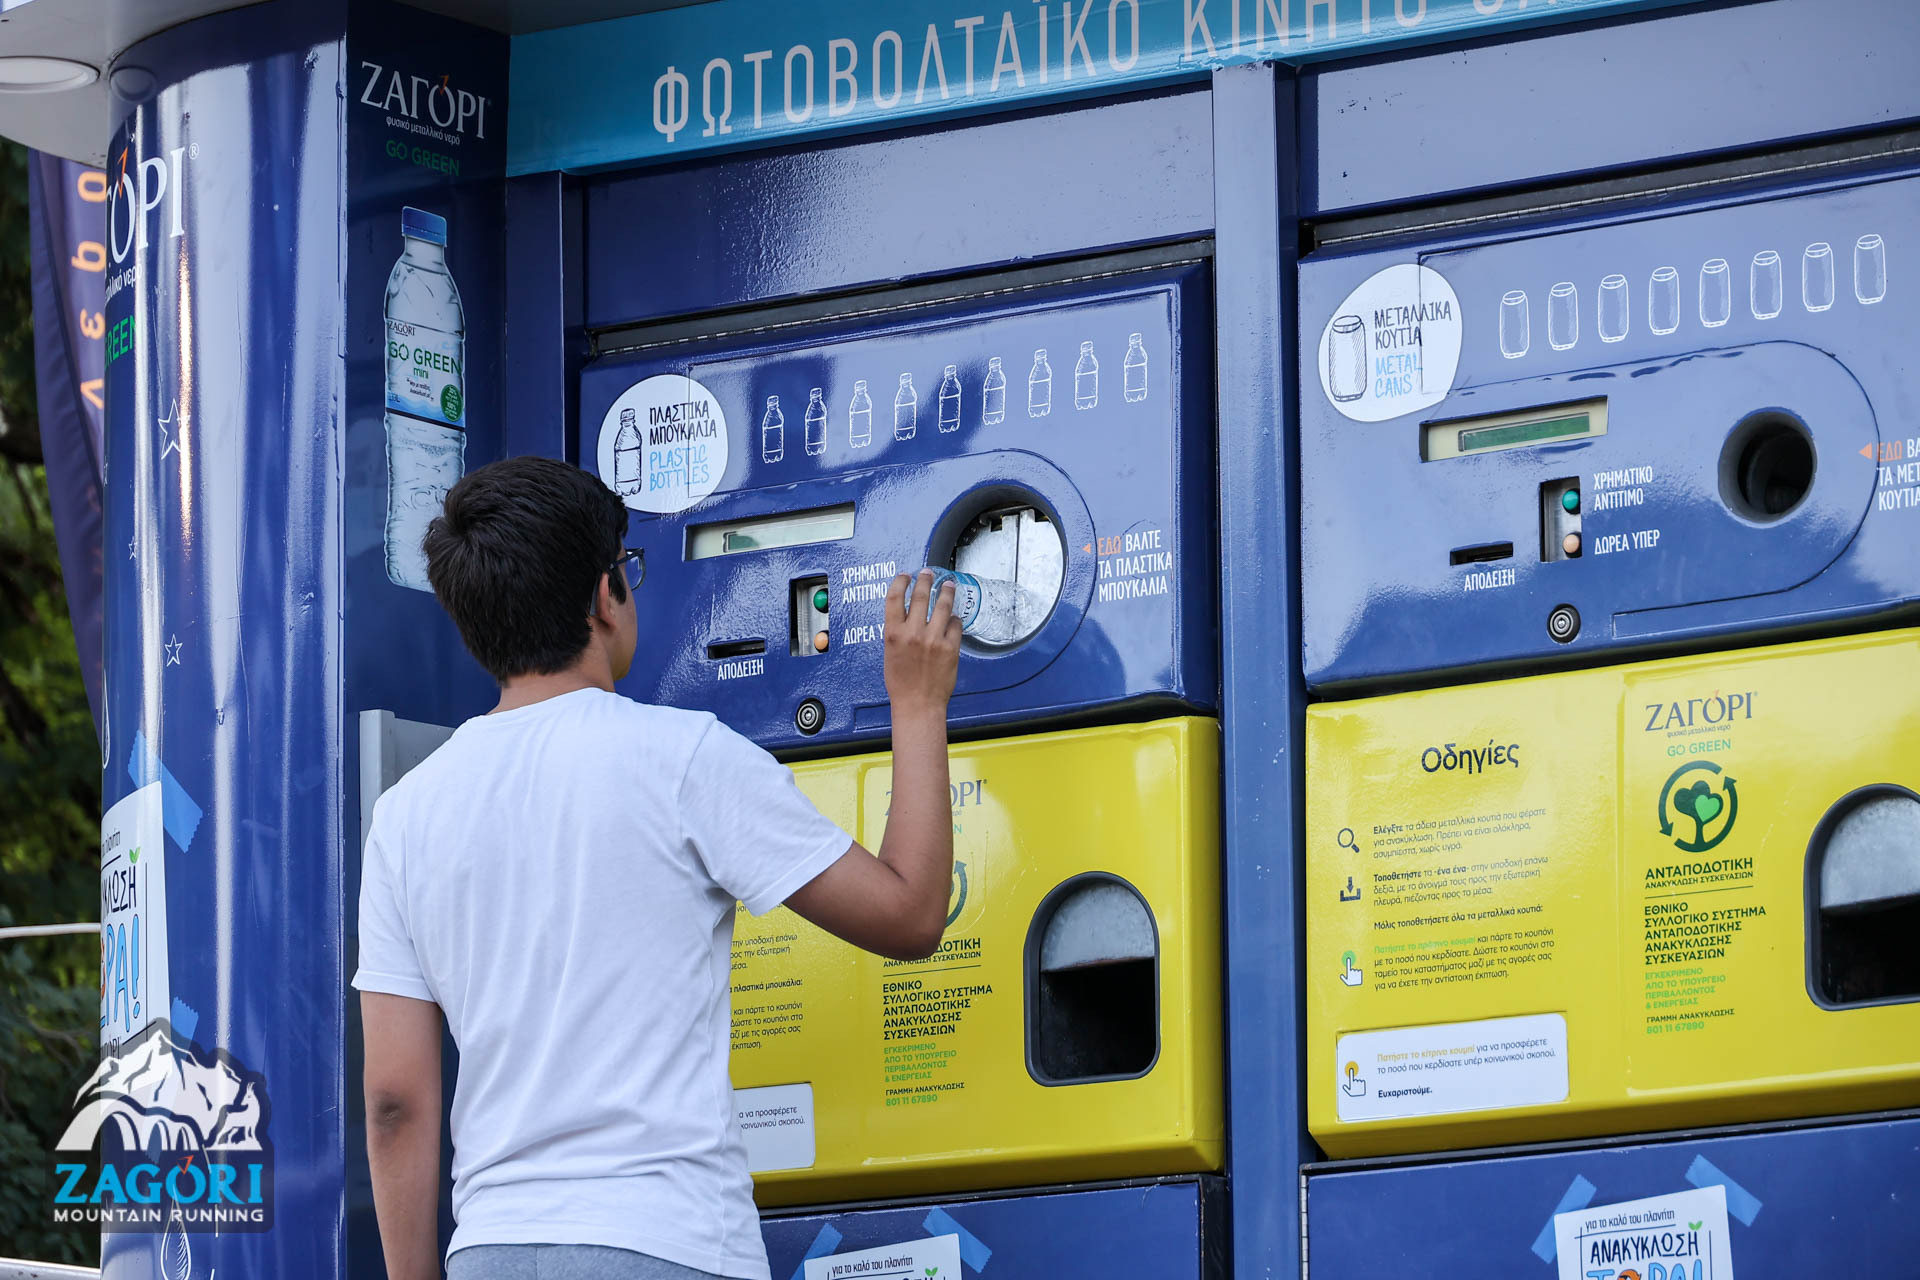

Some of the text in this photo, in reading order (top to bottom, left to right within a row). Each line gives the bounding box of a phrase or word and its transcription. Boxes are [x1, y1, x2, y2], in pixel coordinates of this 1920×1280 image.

[386, 140, 460, 176] GO GREEN
[1375, 301, 1452, 329] ΜΕΤΑΛΛΙΚΑ
[1375, 326, 1422, 350] ΚΟΥΤΙΑ
[389, 341, 463, 376] GO GREEN
[1375, 353, 1423, 377] METAL
[413, 367, 429, 379] mini
[1375, 374, 1413, 398] CANS
[650, 400, 710, 425] ΠΛΑΣΤΙΚΑ
[650, 419, 717, 446] ΜΠΟΥΚΑΛΙΑ
[650, 444, 708, 470] PLASTIC
[650, 464, 710, 491] BOTTLES
[1593, 466, 1653, 490] ΧΡΗΜΑΤΙΚΟ
[1877, 466, 1893, 486] ΤΑ
[1594, 488, 1644, 511] ΑΝΤΙΤΙΜΟ
[1097, 530, 1161, 556] ΕΔΩ ΒΑΛΤΕ
[1594, 529, 1660, 555] ΔΩΡΕΑ ΥΠΕΡ
[841, 561, 896, 584] ΧΡΗΜΑΤΙΚΟ
[1098, 551, 1172, 579] ΤΑ ΠΛΑΣΤΙΚΑ
[1099, 576, 1168, 602] ΜΠΟΥΚΑΛΙΑ
[1464, 568, 1515, 591] ΑΠΟΔΕΙΞΗ
[842, 583, 887, 604] ΑΝΤΙΤΙΜΟ
[843, 625, 876, 645] ΔΩΡΕΑ
[718, 659, 764, 681] ΑΠΟΔΕΙΞΗ
[1421, 739, 1519, 774] Οδηγίες
[1667, 739, 1731, 757] GO GREEN
[1645, 857, 1753, 880] ΑΝΤΑΠΟΔΟΤΙΚΗ
[1645, 871, 1753, 889] ΑΝΑΚΥΚΛΩΣΗ ΣΥΣΚΕΥΑΣΙΩΝ
[1644, 902, 1688, 916] ΕΘΝΙΚΟ
[1645, 906, 1766, 928] ΣΥΛΛΟΓΙΚΟ ΣΥΣΤΗΜΑ
[1645, 921, 1742, 940] ΑΝΤΑΠΟΔΟΤΙΚΗΣ
[1645, 935, 1732, 953] ΑΝΑΚΥΚΛΩΣΗΣ
[933, 951, 981, 962] ΣΥΣΚΕΥΑΣΙΩΝ
[1645, 948, 1725, 965] ΣΥΣΚΕΥΑΣΙΩΝ
[734, 982, 764, 993] πλαστικά
[883, 980, 922, 993] ΕΘΝΙΚΟ
[883, 985, 993, 1005] ΣΥΛΛΟΓΙΚΟ ΣΥΣΤΗΜΑ
[883, 999, 971, 1016] ΑΝΤΑΠΟΔΟΤΙΚΗΣ
[1646, 1008, 1735, 1023] ΓΡΑΜΜΗ ΑΝΑΚΥΚΛΩΣΗΣ
[883, 1012, 962, 1028] ΑΝΑΚΥΚΛΩΣΗΣ
[884, 1024, 955, 1040] ΣΥΣΚΕΥΑΣΙΩΝ
[885, 1082, 965, 1096] ΓΡΑΜΜΗ ΑΝΑΚΥΚΛΩΣΗΣ
[1378, 1085, 1432, 1098] Ευχαριστούμε.
[1586, 1208, 1675, 1232] για το καλό του πλανήτη
[1591, 1231, 1698, 1266] ΑΝΑΚΥΚΛΩΣΗ
[832, 1254, 913, 1277] για το καλό του πλανήτη
